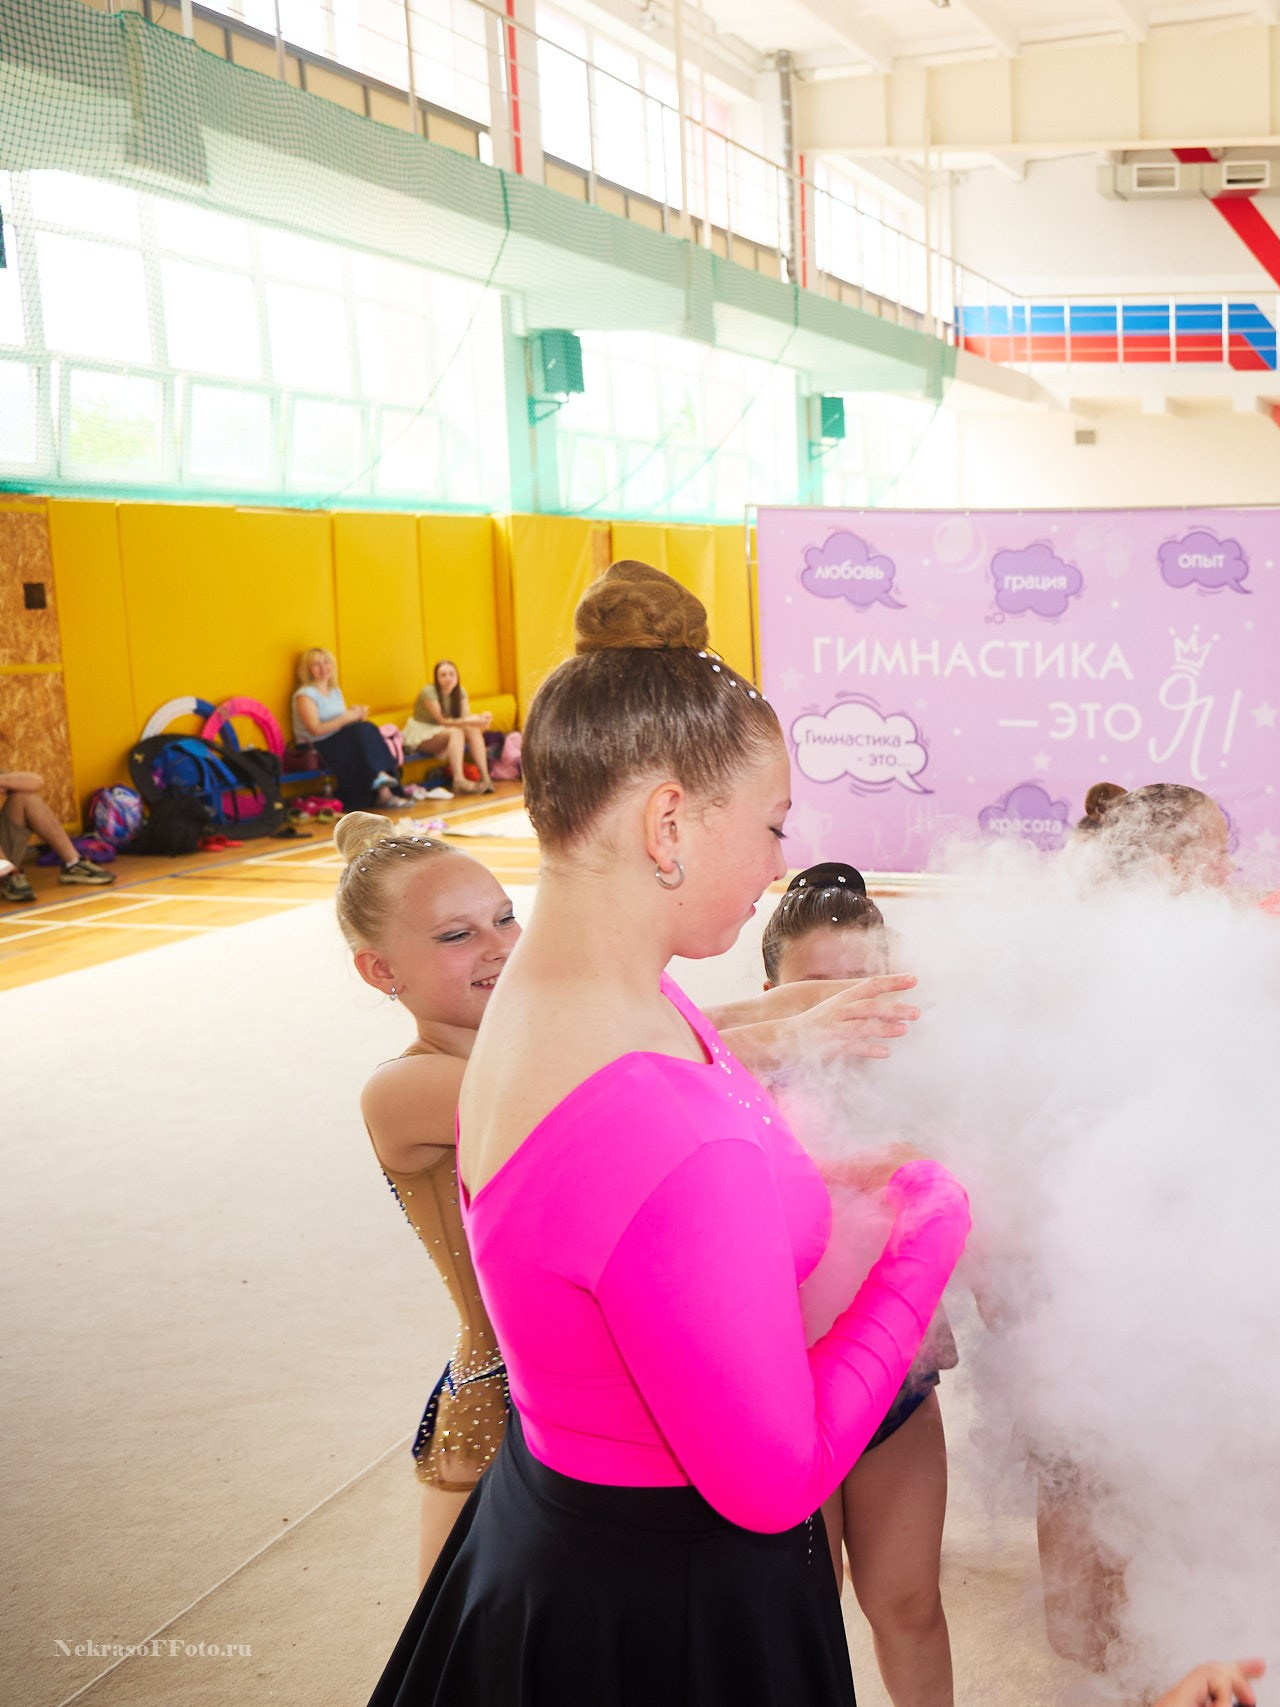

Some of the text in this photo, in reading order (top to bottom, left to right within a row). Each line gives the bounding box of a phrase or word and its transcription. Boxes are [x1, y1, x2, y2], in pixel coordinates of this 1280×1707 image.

[1177, 553, 1225, 568] опыт
[815, 559, 885, 581] любовь
[1003, 574, 1068, 592] грация
[812, 636, 1134, 681] ГИМНАСТИКА
[1049, 702, 1142, 741] ЭТО
[805, 730, 902, 747] Гимнастика
[988, 818, 1062, 833] красота
